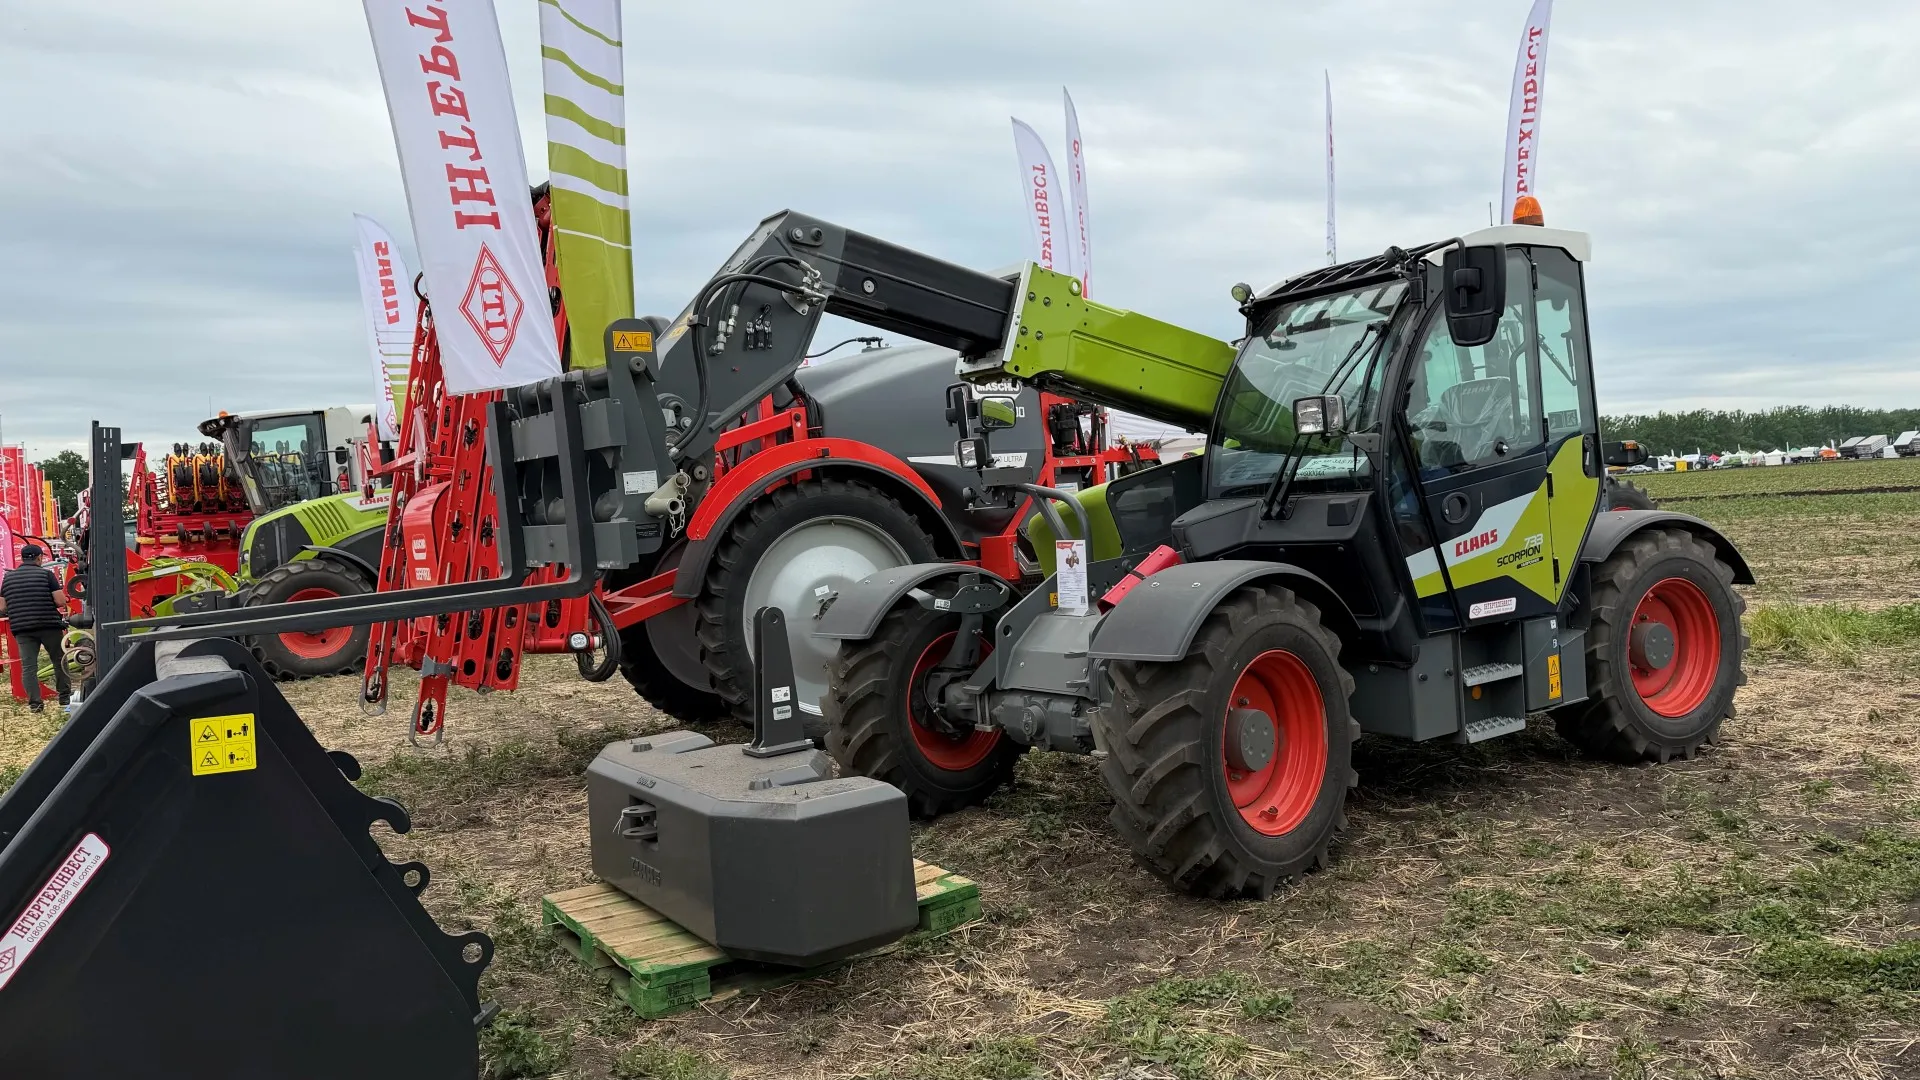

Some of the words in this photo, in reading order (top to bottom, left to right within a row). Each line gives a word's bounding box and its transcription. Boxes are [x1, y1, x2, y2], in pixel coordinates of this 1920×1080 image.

[1003, 455, 1023, 463] ULTRA
[1455, 528, 1498, 558] CLAAS
[1524, 533, 1544, 549] 733
[1497, 545, 1541, 568] SCORPION
[11, 846, 91, 939] ІНТЕРТЕХІНВЕСТ
[47, 889, 72, 920] 408-888
[70, 854, 101, 889] iti.com.ua
